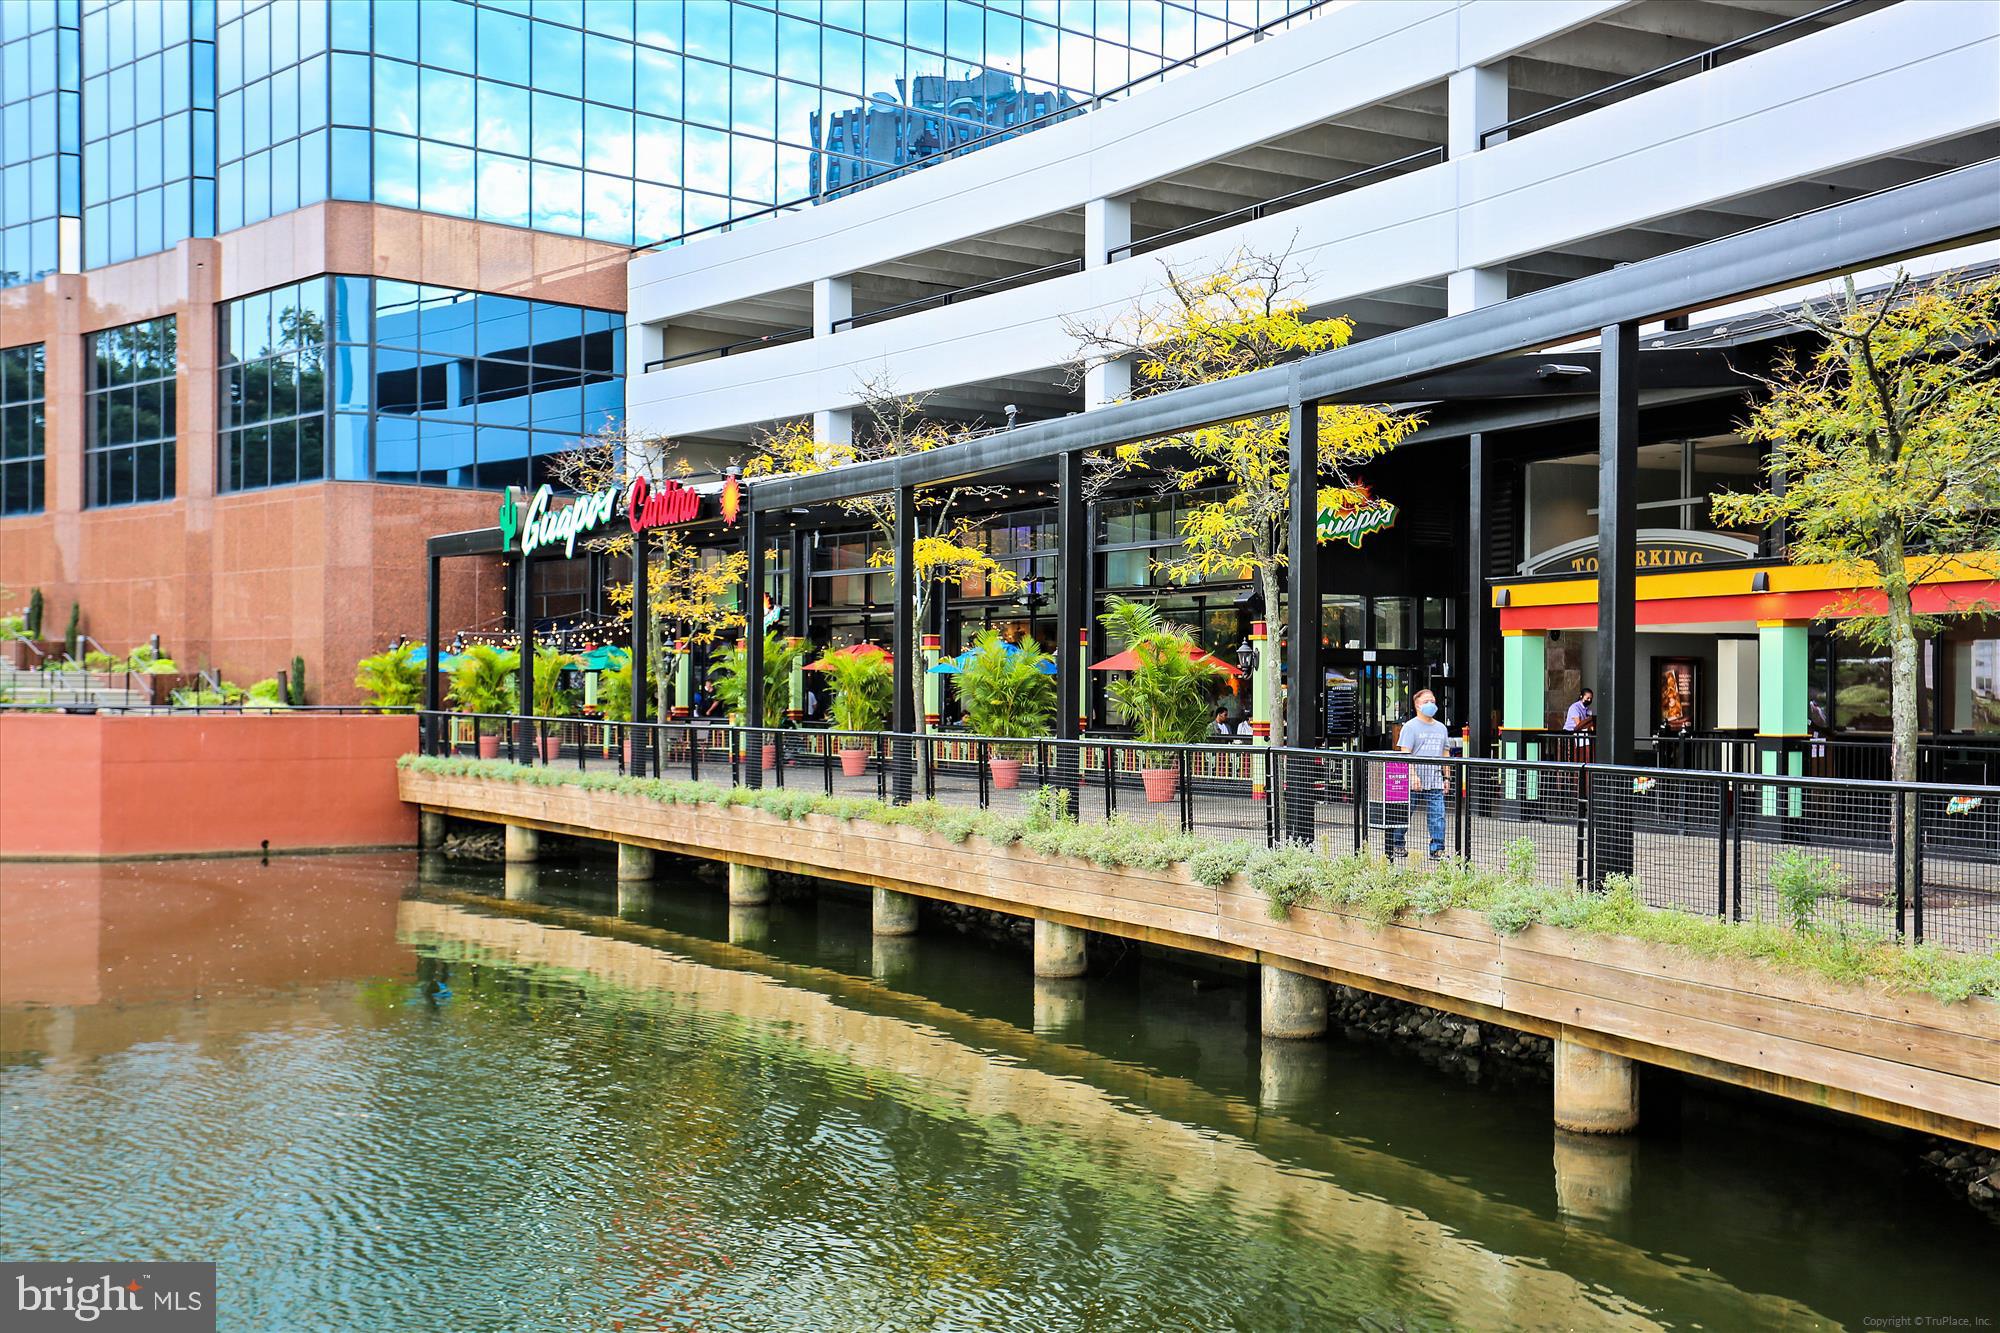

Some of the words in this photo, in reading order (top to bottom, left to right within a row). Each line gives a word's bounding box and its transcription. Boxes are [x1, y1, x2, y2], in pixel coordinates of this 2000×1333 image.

[521, 483, 619, 559] Guapos
[628, 475, 701, 533] Cantina
[1636, 549, 1704, 567] RKING
